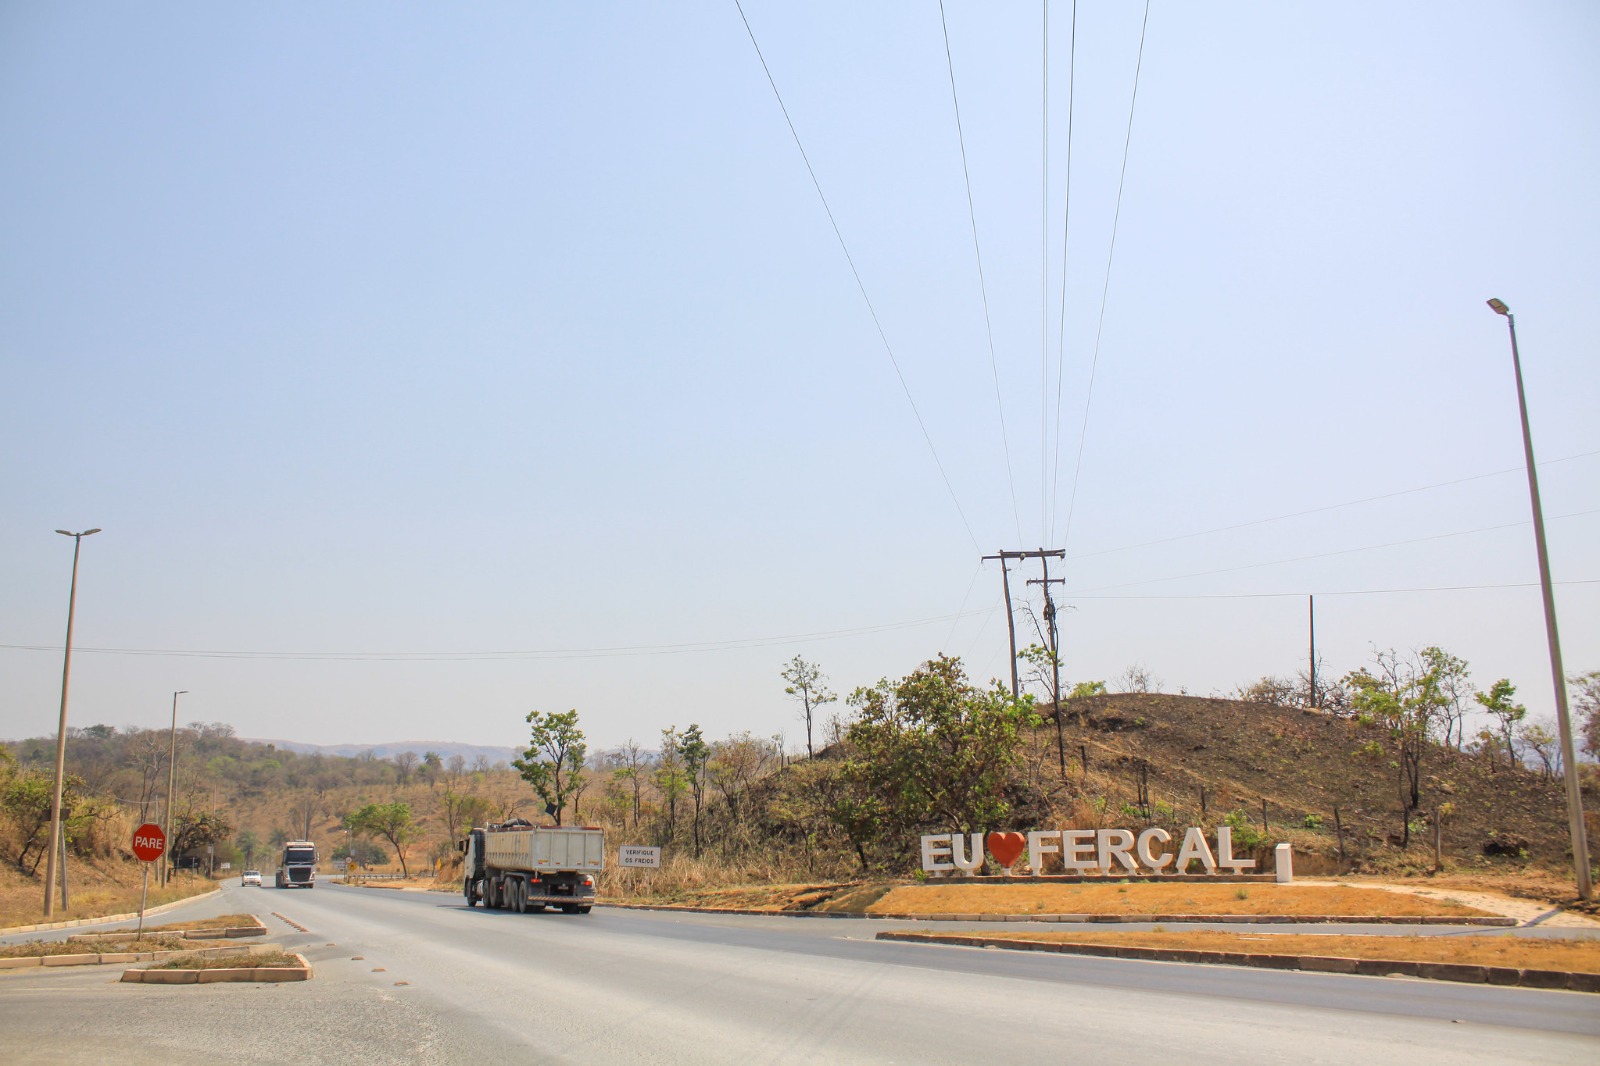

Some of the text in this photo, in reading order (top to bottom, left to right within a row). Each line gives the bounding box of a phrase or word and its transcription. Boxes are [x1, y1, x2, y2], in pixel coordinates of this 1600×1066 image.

[135, 836, 163, 849] PARE
[921, 827, 1256, 871] EU FERCAL
